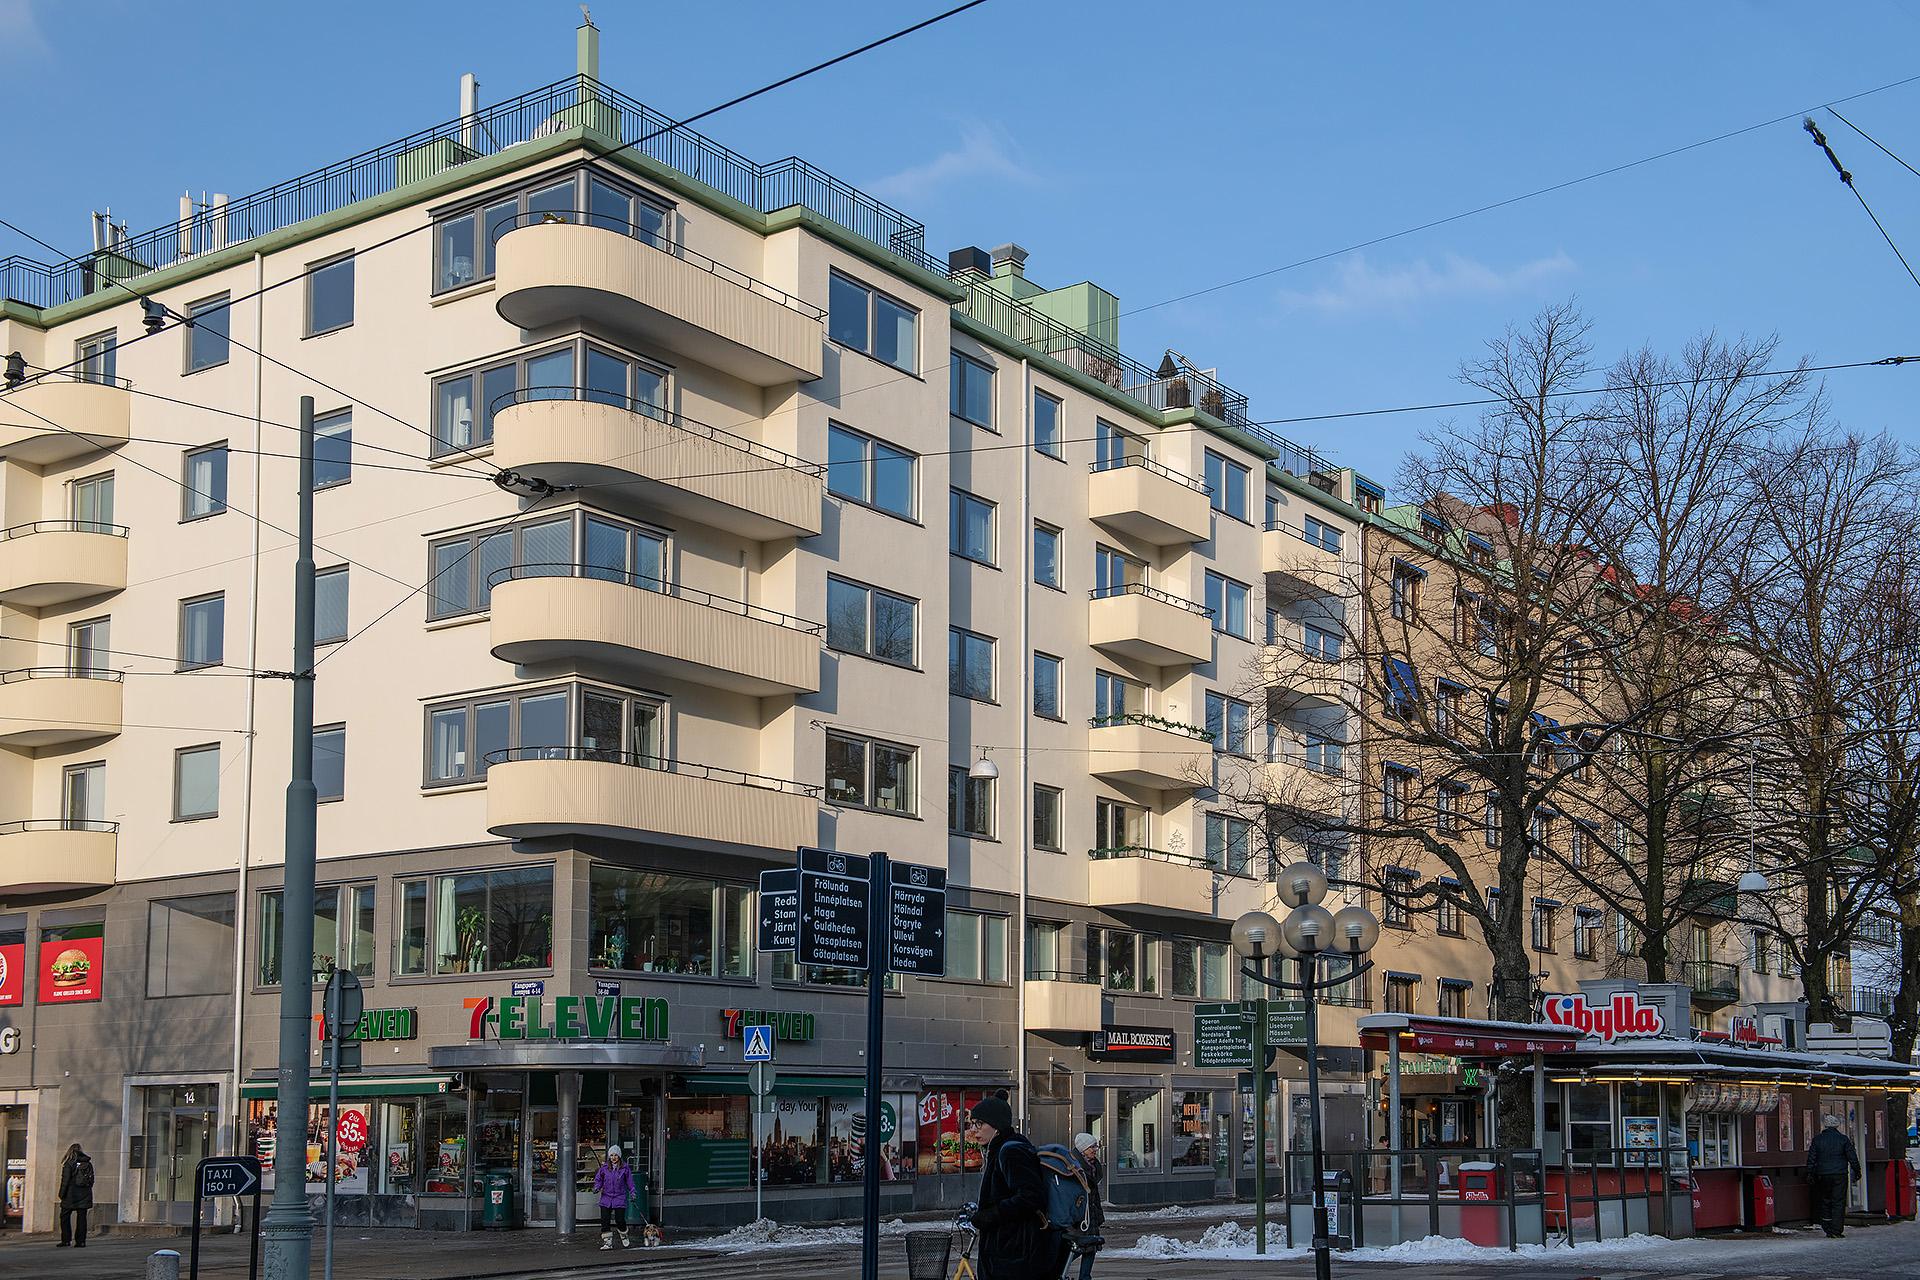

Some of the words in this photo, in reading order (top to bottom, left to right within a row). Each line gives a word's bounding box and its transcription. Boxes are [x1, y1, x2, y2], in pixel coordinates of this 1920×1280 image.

[814, 878, 849, 892] Frölunda
[814, 892, 863, 908] Linnéplatsen
[894, 890, 925, 904] Härryda
[814, 906, 835, 919] Haga
[894, 903, 922, 916] Mölndal
[814, 920, 856, 935] Guldheden
[893, 914, 922, 930] Örgryte
[814, 935, 862, 949] Vasaplatsen
[893, 930, 915, 942] Ullevi
[813, 949, 859, 962] Götaplatsen
[893, 944, 933, 957] Korsvägen
[893, 957, 917, 968] Heden
[1546, 996, 1659, 1041] Sibylla
[1735, 1018, 1757, 1042] Sibylla
[1108, 1032, 1130, 1044] MAIL
[1130, 1033, 1155, 1046] BOXES
[184, 1092, 195, 1104] 14
[780, 1100, 797, 1112] day.
[798, 1100, 817, 1112] Your
[830, 1102, 848, 1115] way.
[923, 1096, 938, 1122] 39
[340, 1120, 365, 1142] 35:-
[208, 1169, 232, 1180] TAXI
[206, 1182, 224, 1191] 150
